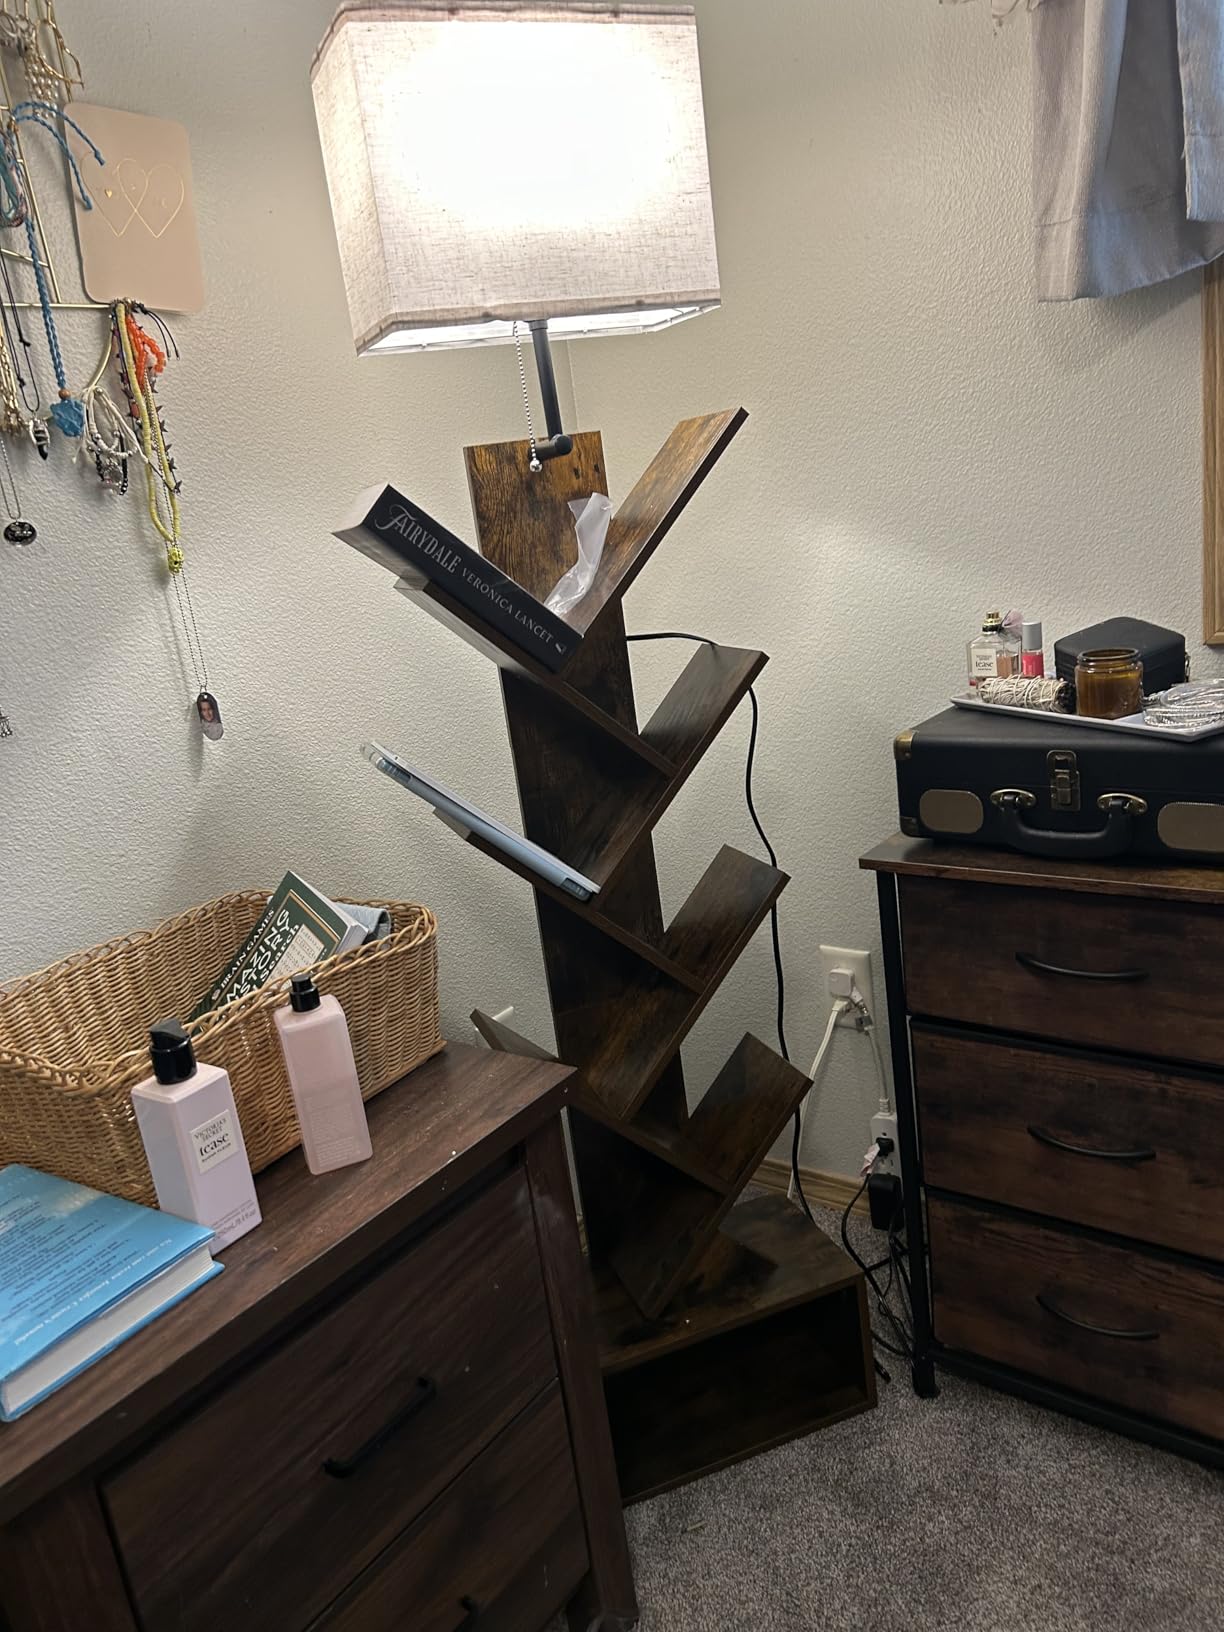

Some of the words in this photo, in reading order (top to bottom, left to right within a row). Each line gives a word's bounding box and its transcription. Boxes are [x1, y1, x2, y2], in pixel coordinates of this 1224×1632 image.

[374, 503, 462, 574] FAIRYDALE
[461, 567, 514, 615] VERONICA
[514, 609, 554, 643] LANCET
[221, 951, 247, 988] BRAIN
[246, 909, 275, 951] GAMES
[260, 924, 300, 982] Search
